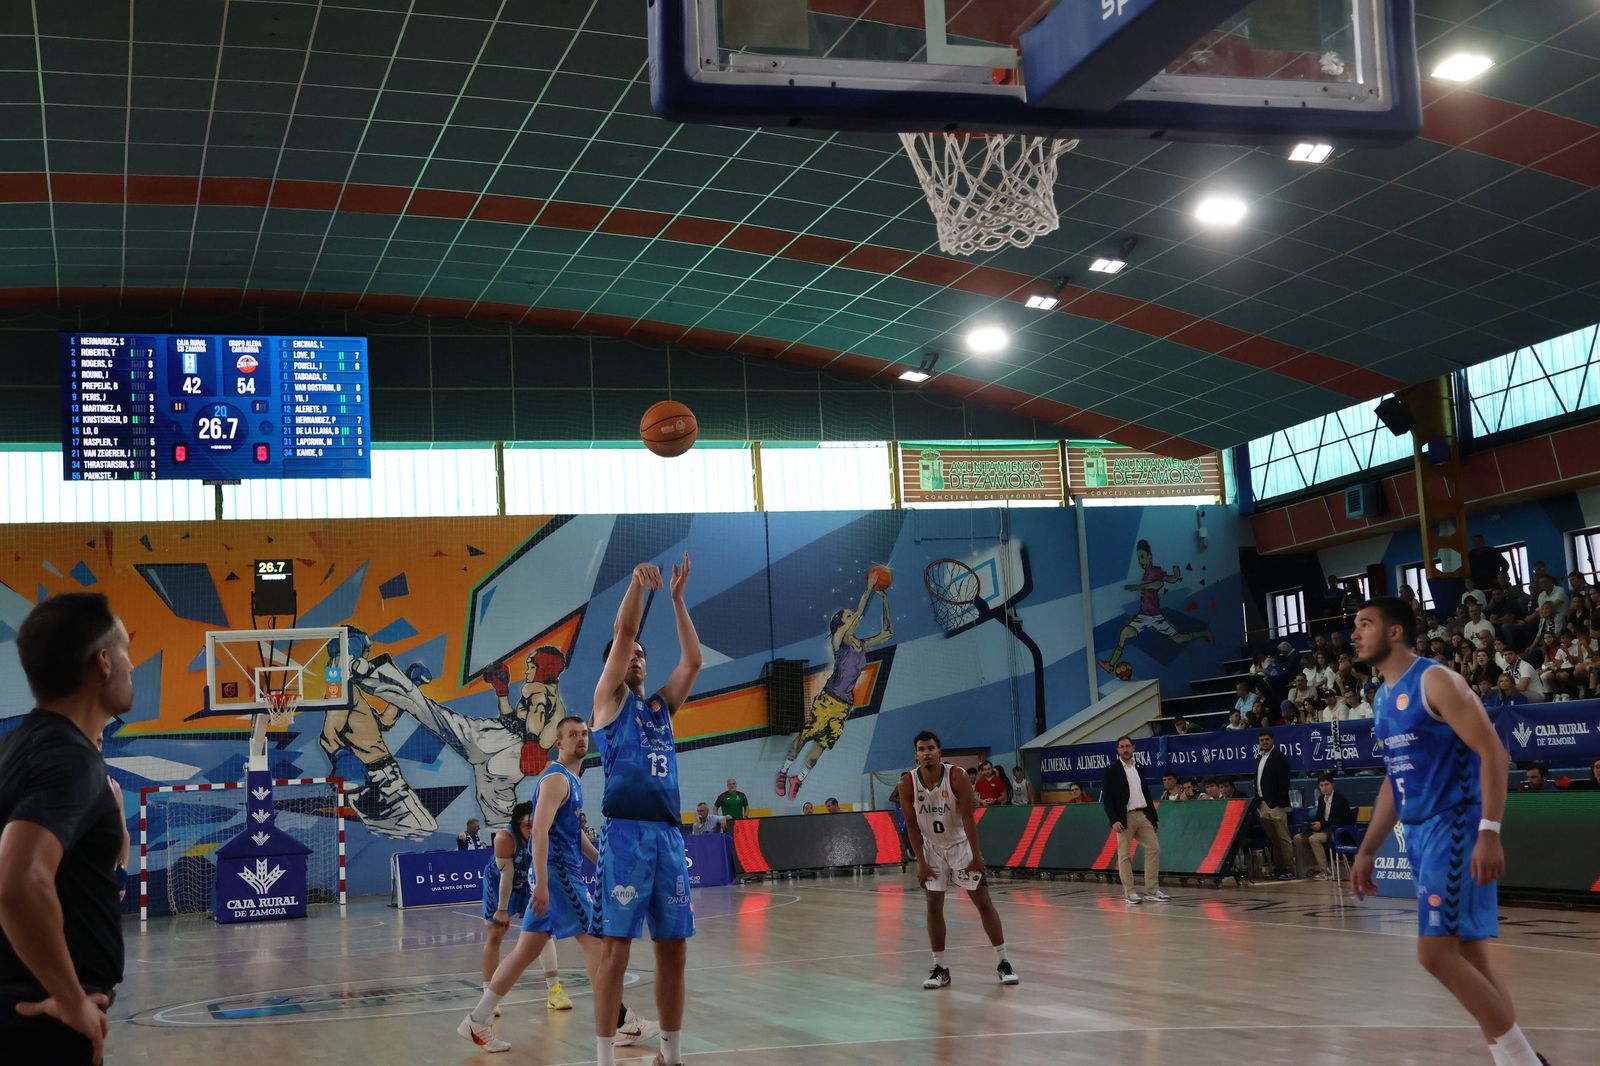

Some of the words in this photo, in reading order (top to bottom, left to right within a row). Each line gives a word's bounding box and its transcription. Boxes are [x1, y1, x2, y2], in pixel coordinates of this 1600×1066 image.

[80, 337, 119, 346] HERNANDEZ,
[120, 338, 124, 346] S
[293, 340, 319, 348] ENCINAS,
[71, 348, 76, 356] 2
[81, 348, 110, 357] ROBERTS,
[148, 349, 153, 357] 7
[294, 351, 310, 359] LOVE,
[71, 360, 76, 368] 3
[81, 360, 107, 368] ROGERS,
[108, 360, 113, 368] C
[148, 360, 153, 368] 8
[294, 362, 318, 370] POWELL,
[319, 362, 322, 370] J
[82, 371, 104, 380] ROUND,
[105, 371, 108, 379] J
[148, 371, 154, 380] 3
[294, 373, 322, 381] TABOADA,
[72, 382, 76, 390] 5
[82, 382, 112, 390] PREPELIC,
[113, 382, 118, 390] B
[183, 377, 201, 394] 42
[237, 378, 255, 394] 54
[82, 393, 102, 402] PERIS,
[103, 393, 106, 401] J
[82, 405, 115, 413] MARTINEZ,
[214, 405, 227, 417] 2Q
[83, 416, 122, 424] KRISTENSEN,
[150, 416, 155, 424] 2
[296, 416, 331, 424] HERNANDEZ,
[332, 416, 336, 424] P
[357, 416, 361, 424] 7
[72, 427, 80, 435] 15
[199, 418, 238, 439] 26.7
[304, 427, 312, 435] LA
[313, 427, 334, 436] LLAMA,
[334, 427, 339, 435] B
[72, 438, 80, 446] 17
[113, 438, 118, 446] T
[150, 438, 155, 446] 5
[327, 438, 332, 446] M
[72, 449, 80, 457] 21
[83, 449, 96, 457] VAN
[127, 449, 131, 457] J
[296, 449, 318, 458] KANDE,
[950, 461, 1042, 473] AYUNTAMIENTO
[72, 472, 80, 480] 55
[114, 472, 118, 480] J
[151, 472, 156, 480] 3
[949, 474, 970, 489] DE
[973, 472, 1044, 489] ZAMORA
[1113, 470, 1132, 485] DE
[1136, 469, 1203, 484] ZAMORA
[258, 562, 286, 573] 26.7
[1535, 725, 1557, 736] CAJA
[1558, 722, 1590, 734] RURAL
[1536, 738, 1546, 746] DE
[1548, 736, 1576, 745] ZAMORA
[1168, 750, 1197, 764] ADIS
[1211, 746, 1247, 761] FADIS
[647, 752, 668, 778] 13
[1041, 757, 1072, 772] ALIMERKA
[1077, 754, 1110, 770] ALIMERKA
[1396, 778, 1405, 806] 5
[933, 821, 945, 834] 0
[1374, 857, 1394, 869] CAJA
[1376, 871, 1386, 879] DE
[226, 899, 256, 910] CAJA
[259, 896, 299, 908] RURAL
[234, 910, 247, 918] DE
[250, 907, 287, 917] ZAMORA
